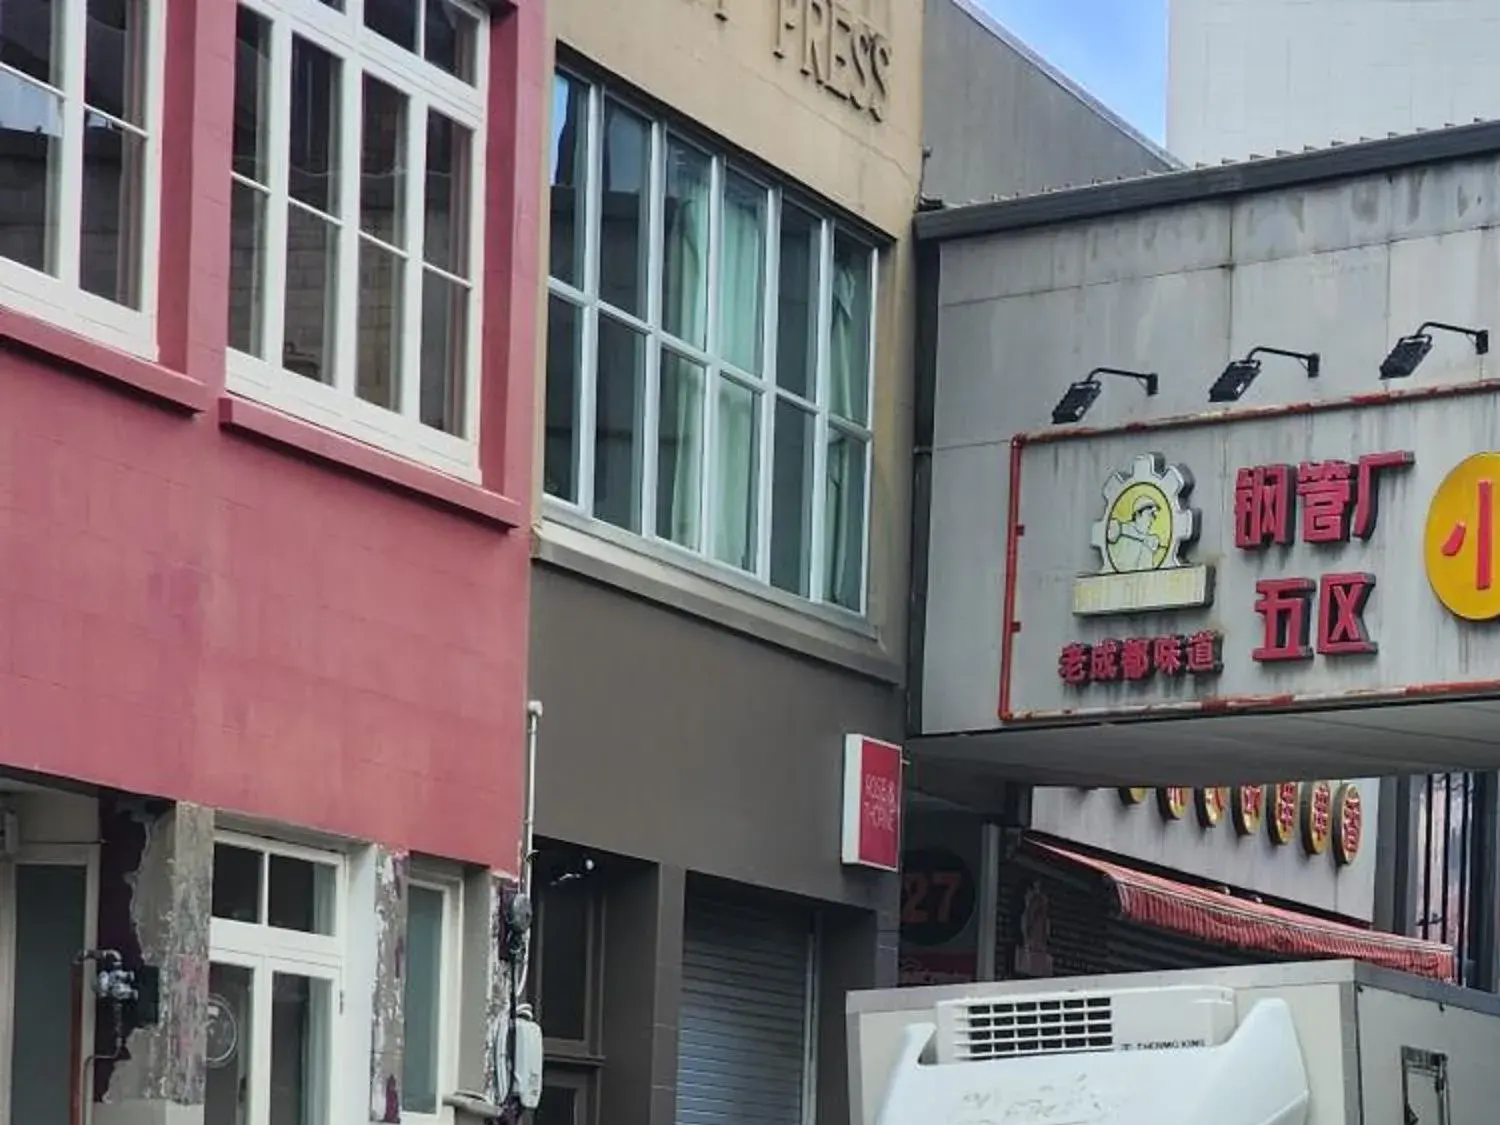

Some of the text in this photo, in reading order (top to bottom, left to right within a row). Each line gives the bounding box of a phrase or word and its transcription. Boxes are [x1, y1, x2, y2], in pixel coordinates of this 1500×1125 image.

[1235, 450, 1412, 548] 钢管厂
[1058, 629, 1224, 686] 老成都味道
[1251, 573, 1378, 661] 五区
